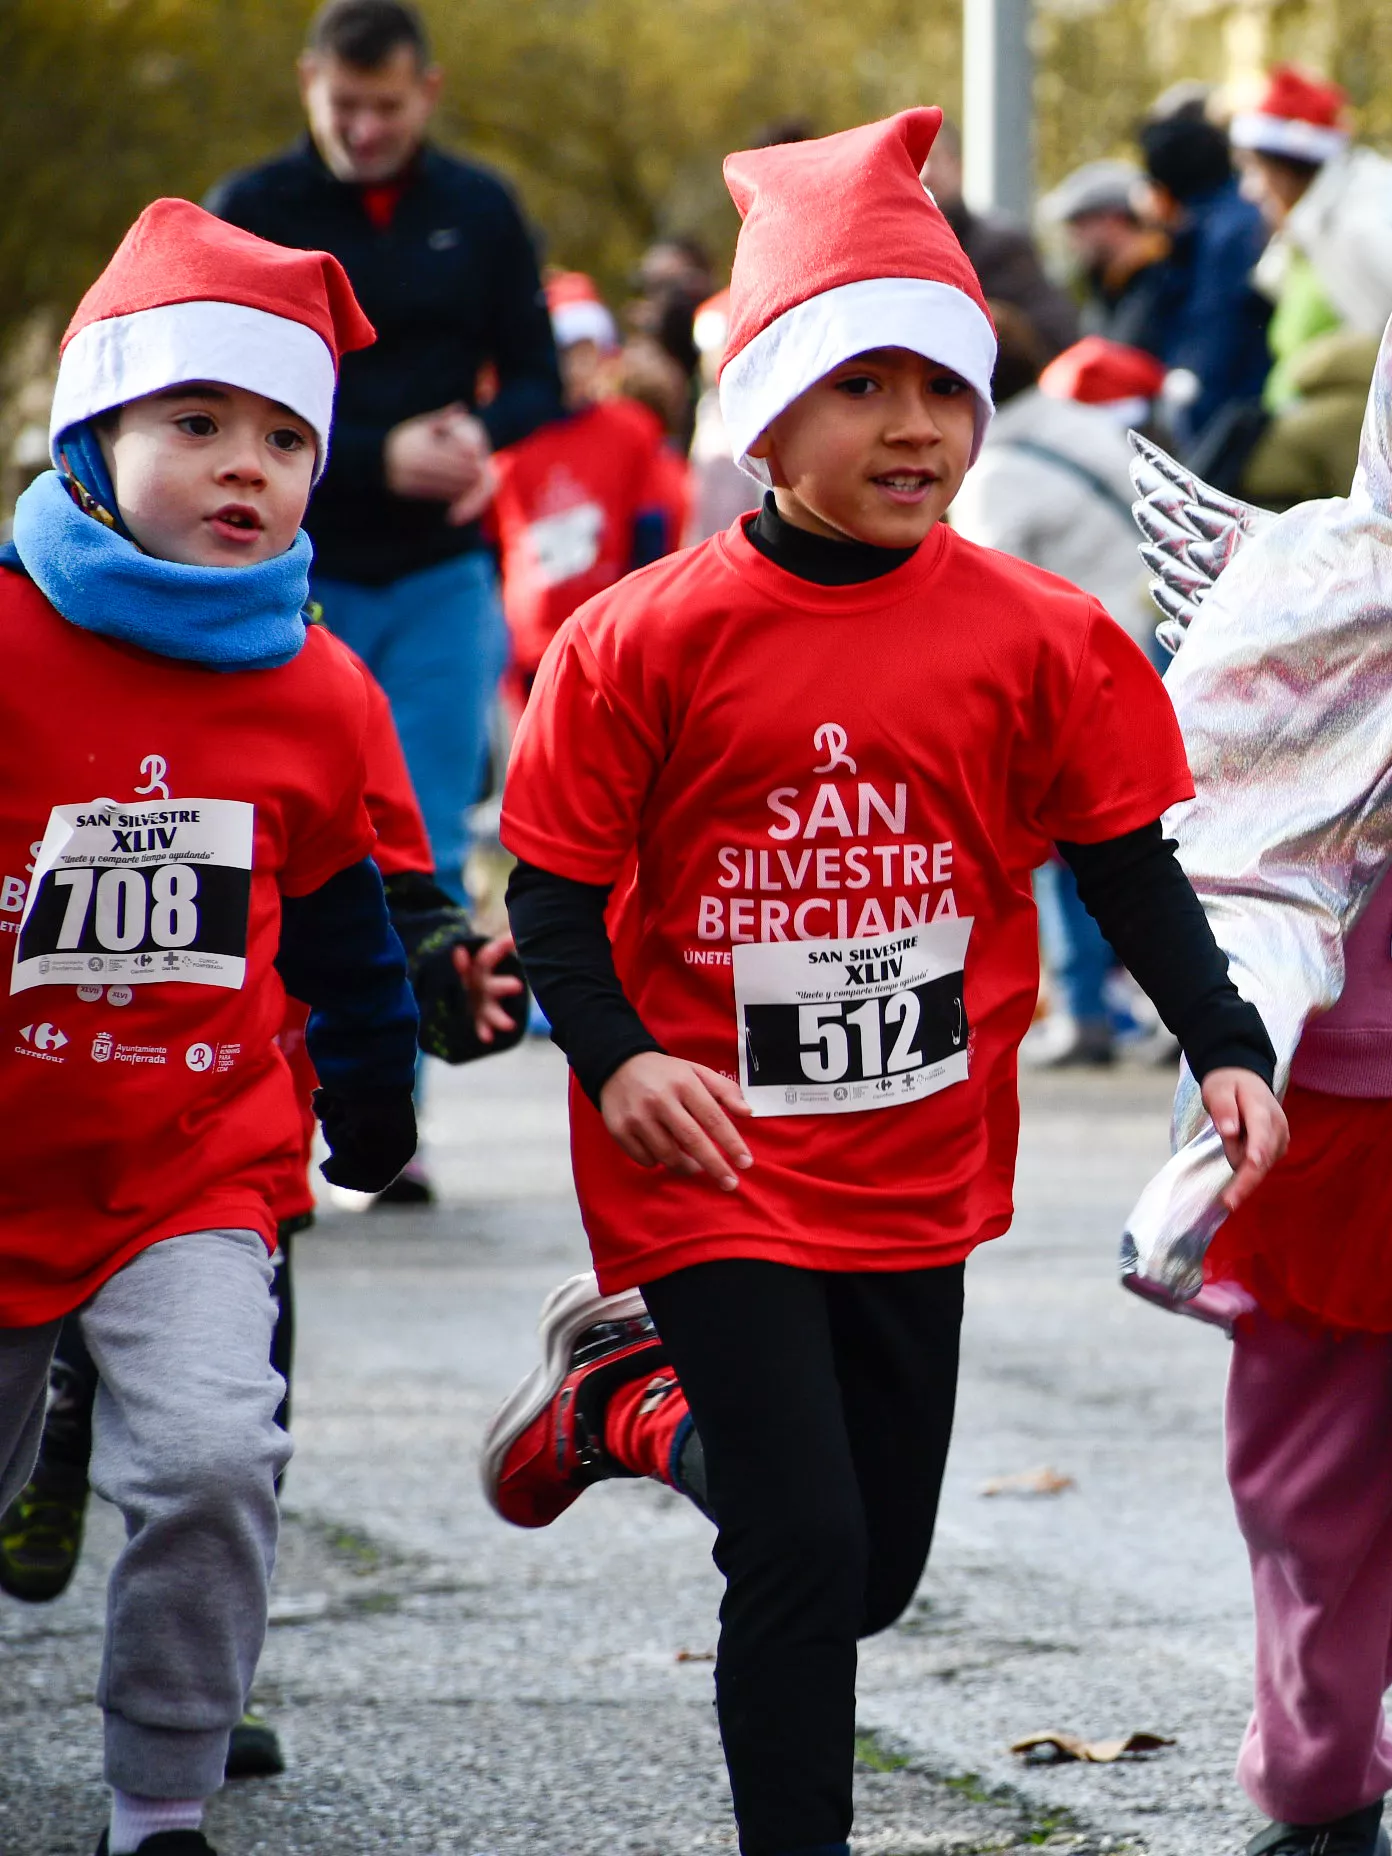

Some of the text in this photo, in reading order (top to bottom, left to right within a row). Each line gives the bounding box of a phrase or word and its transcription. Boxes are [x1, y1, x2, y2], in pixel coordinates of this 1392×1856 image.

[76, 810, 201, 828] SAN SILVESTRE
[766, 782, 907, 841] SAN
[110, 826, 178, 853] XLIV
[98, 855, 140, 865] comparte
[717, 840, 953, 891] SILVESTRE
[54, 863, 198, 952] 708
[697, 888, 959, 943] BERCIANA
[684, 947, 731, 966] ÚNETE
[808, 936, 918, 964] SAN SILVESTRE
[845, 955, 903, 986] XLIV
[117, 1043, 167, 1054] Ayuntamiento
[798, 990, 923, 1083] 512
[14, 1046, 65, 1064] Carrefour
[113, 1053, 166, 1066] Ponferrada
